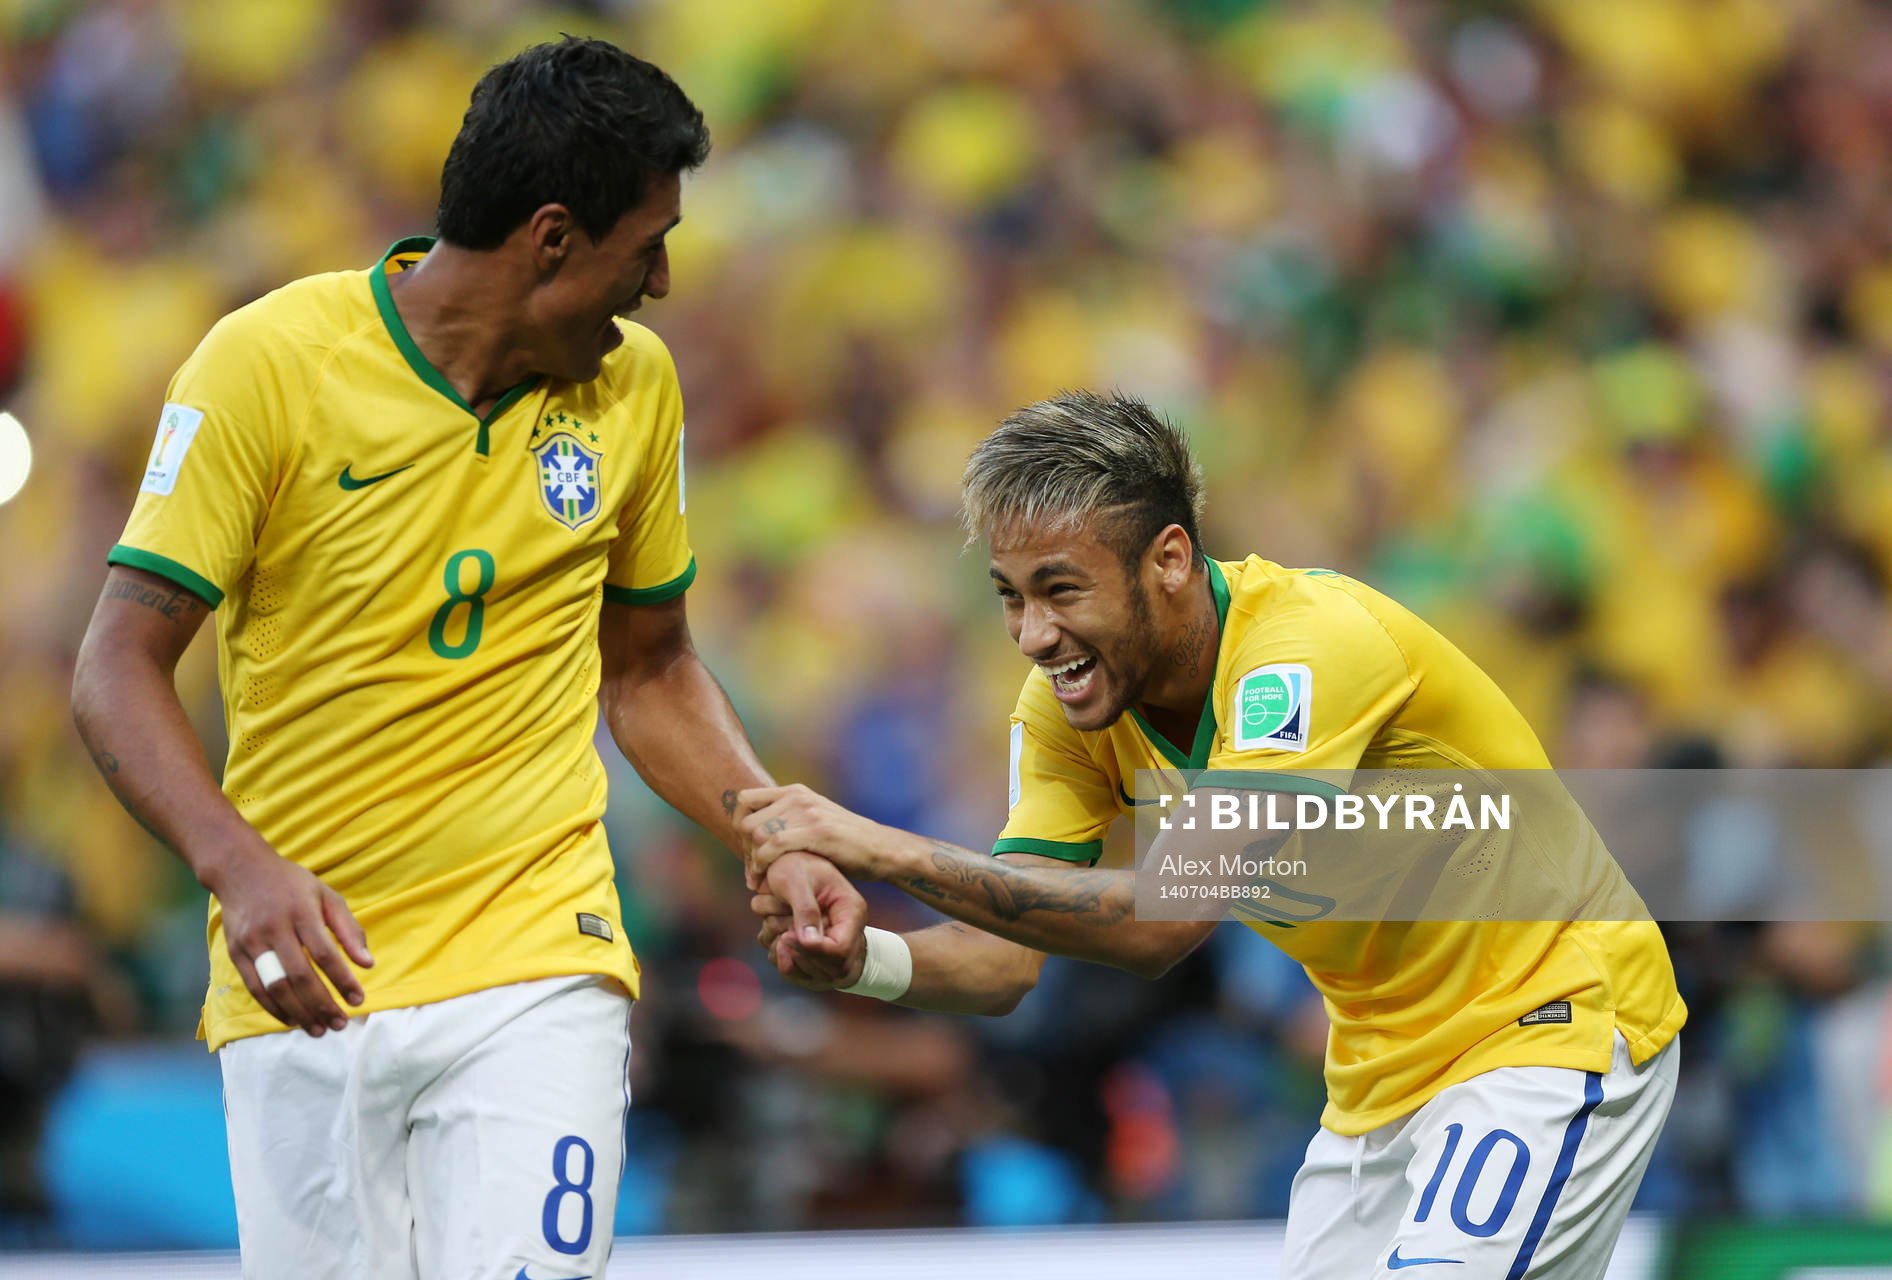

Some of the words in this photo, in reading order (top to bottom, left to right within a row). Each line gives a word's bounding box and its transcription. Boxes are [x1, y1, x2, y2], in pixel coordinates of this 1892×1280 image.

[557, 472, 580, 483] CBF
[428, 549, 495, 660] 8
[1245, 686, 1284, 695] FOOTBALL
[1262, 693, 1283, 701] HOPE
[1280, 731, 1297, 740] FIFA
[1414, 1123, 1531, 1238] 10
[542, 1135, 594, 1255] 8
